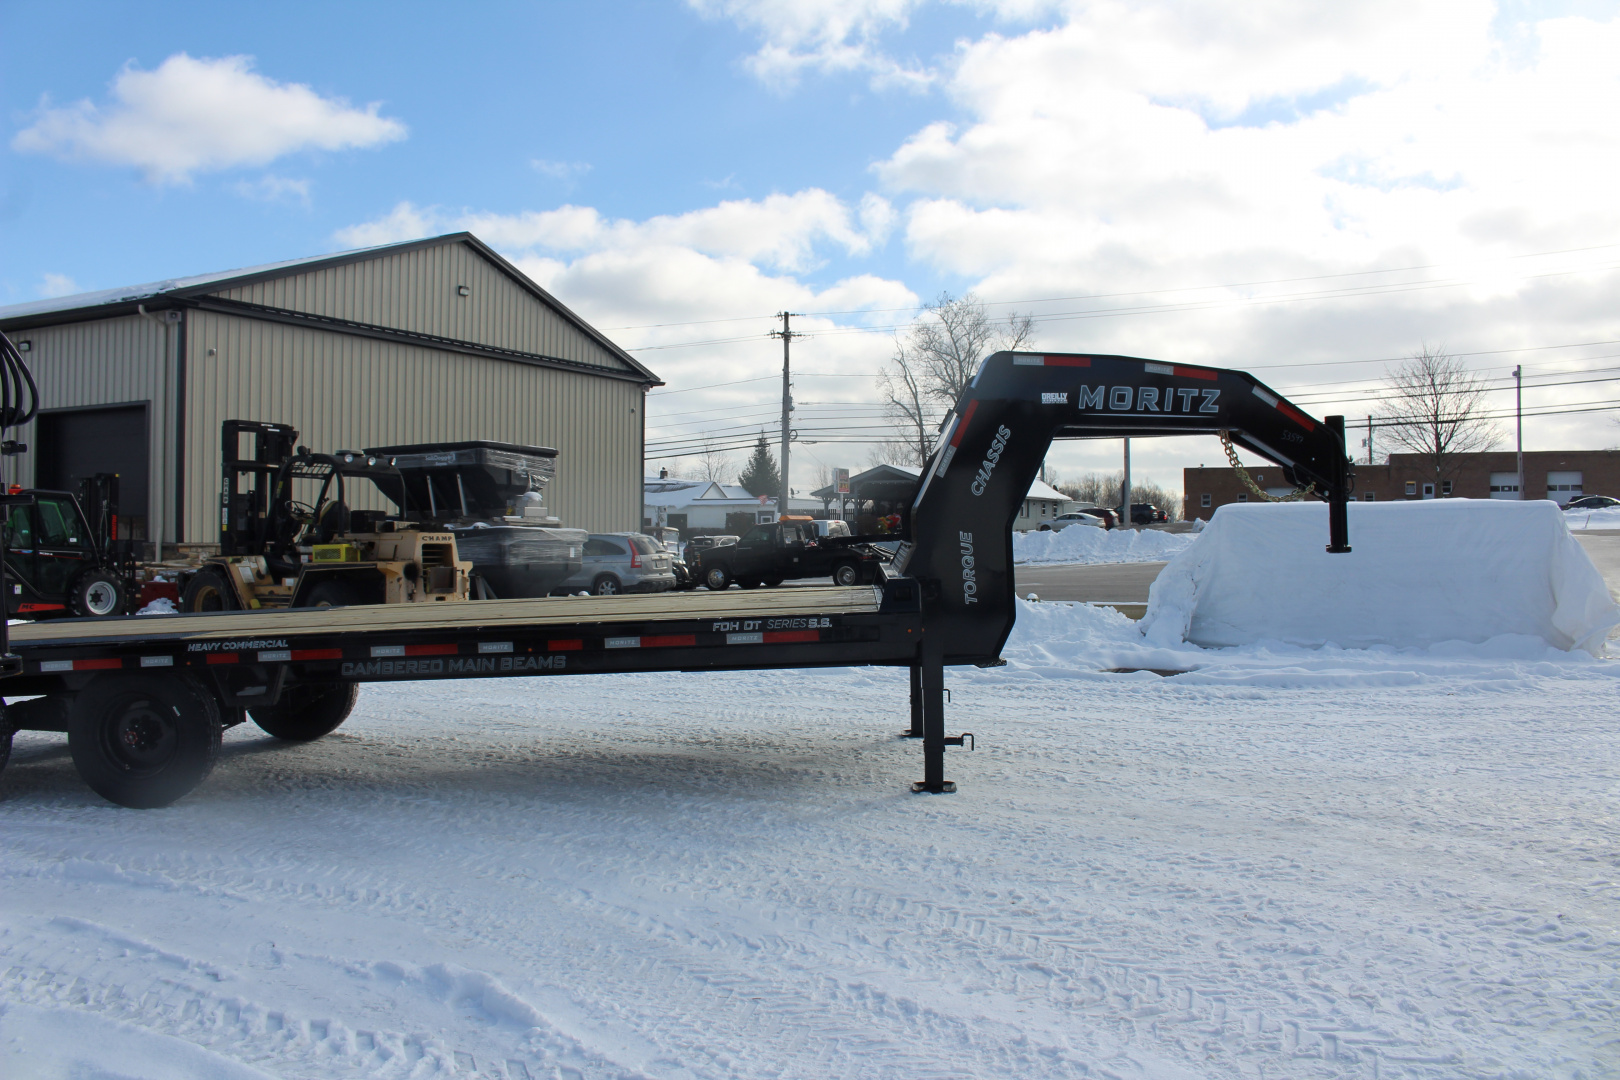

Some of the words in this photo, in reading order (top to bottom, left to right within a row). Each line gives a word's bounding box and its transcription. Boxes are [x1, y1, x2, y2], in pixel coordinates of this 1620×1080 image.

[1078, 385, 1221, 413] MORITZ
[971, 424, 1011, 496] CHASSIS
[959, 531, 978, 604] TORQUE
[766, 618, 807, 630] SERIES
[187, 642, 221, 651] HEAVY
[222, 639, 289, 650] COMMERCIAL
[341, 659, 444, 677] CAMBERED
[448, 658, 495, 673] MAIN
[500, 655, 567, 671] BEAMS
